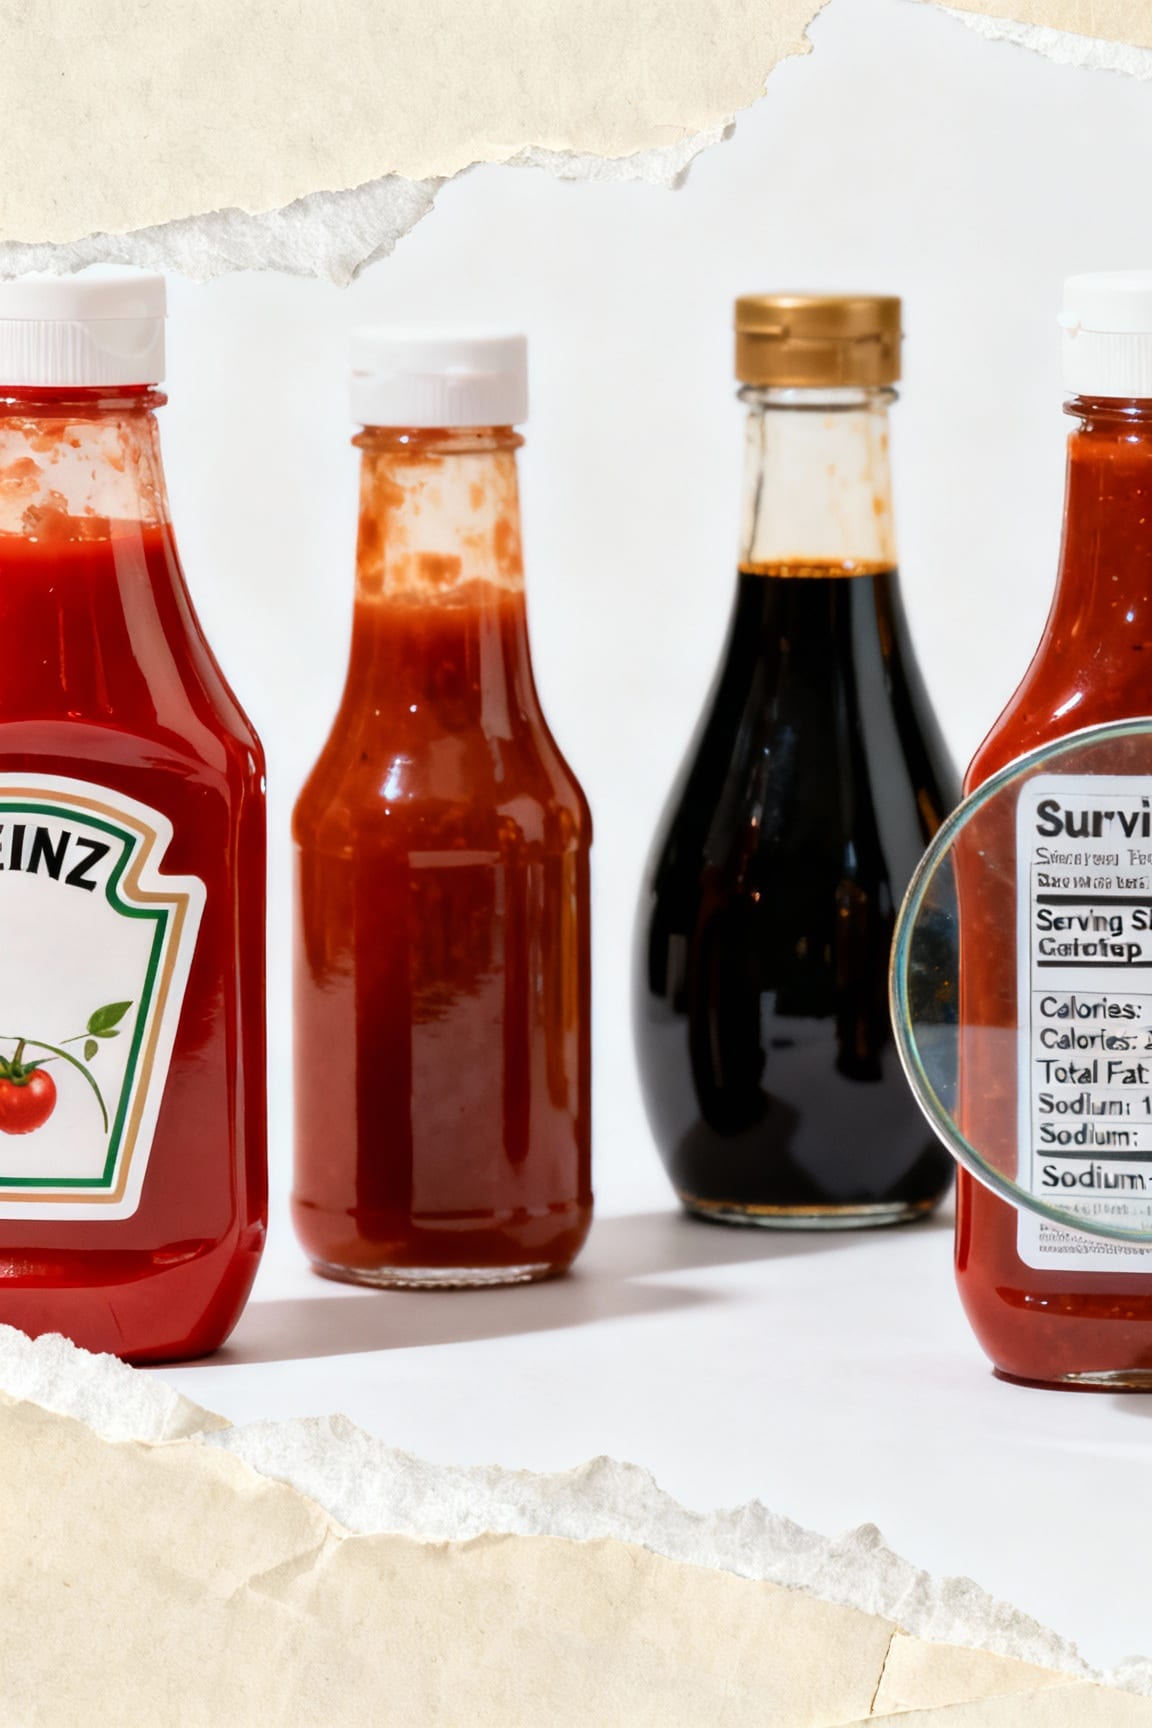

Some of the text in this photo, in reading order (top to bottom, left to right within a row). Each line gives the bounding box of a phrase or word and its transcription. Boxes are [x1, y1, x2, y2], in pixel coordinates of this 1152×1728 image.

[0, 824, 111, 892] INZ
[1040, 996, 1142, 1019] Calories:
[1036, 1059, 1098, 1085] Total
